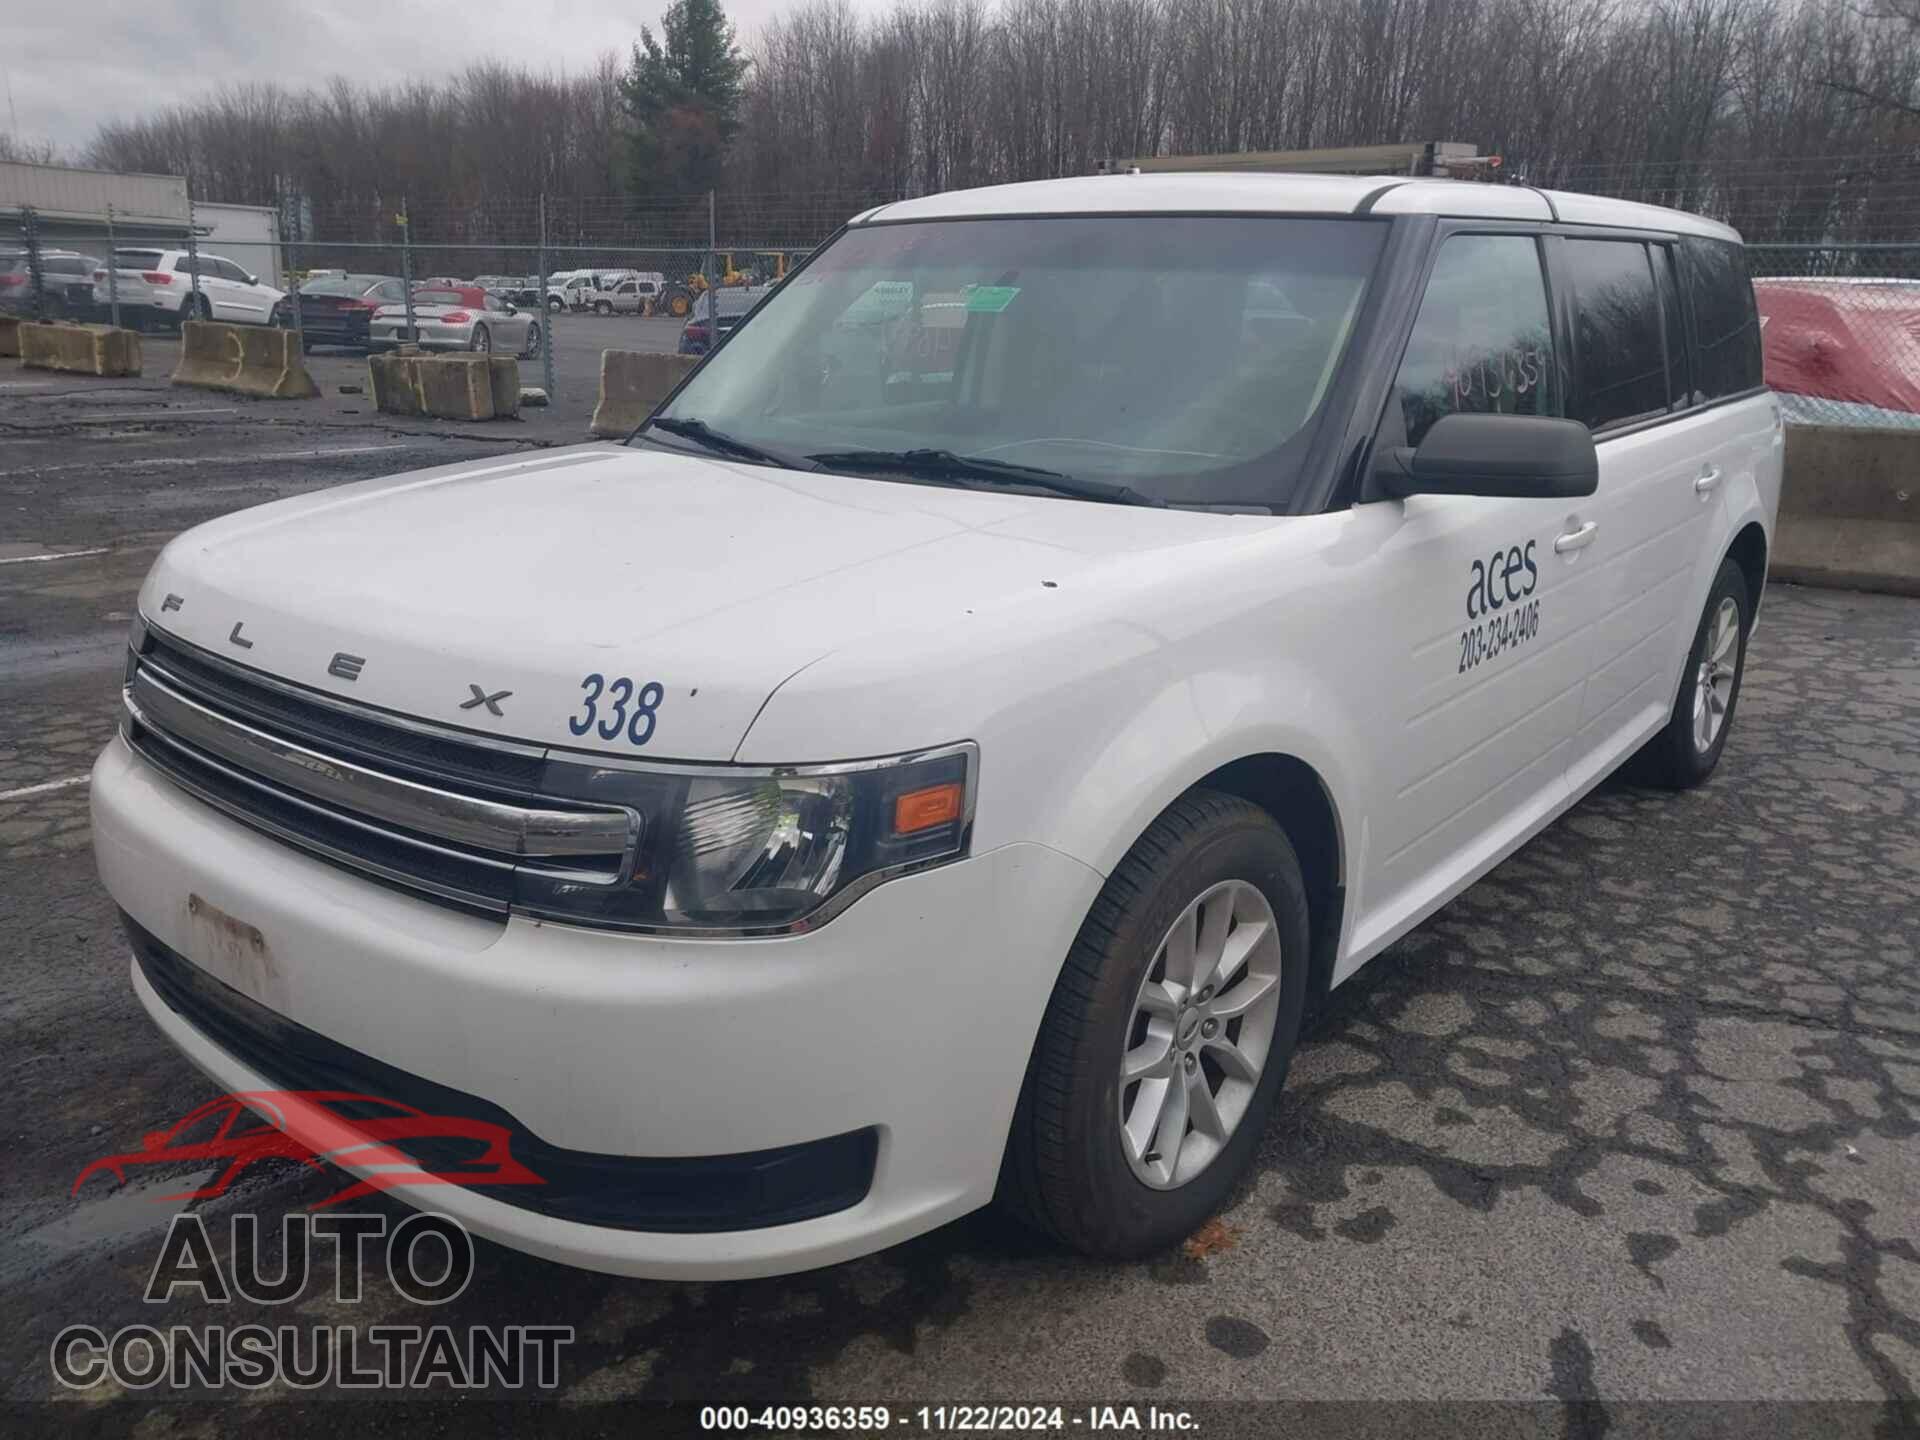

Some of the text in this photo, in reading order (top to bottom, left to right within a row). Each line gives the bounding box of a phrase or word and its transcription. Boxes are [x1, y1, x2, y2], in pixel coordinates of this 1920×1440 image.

[1466, 539, 1538, 620] aces
[161, 593, 514, 717] FLEX
[1458, 599, 1540, 675] 203-234-2406
[569, 673, 664, 746] 338
